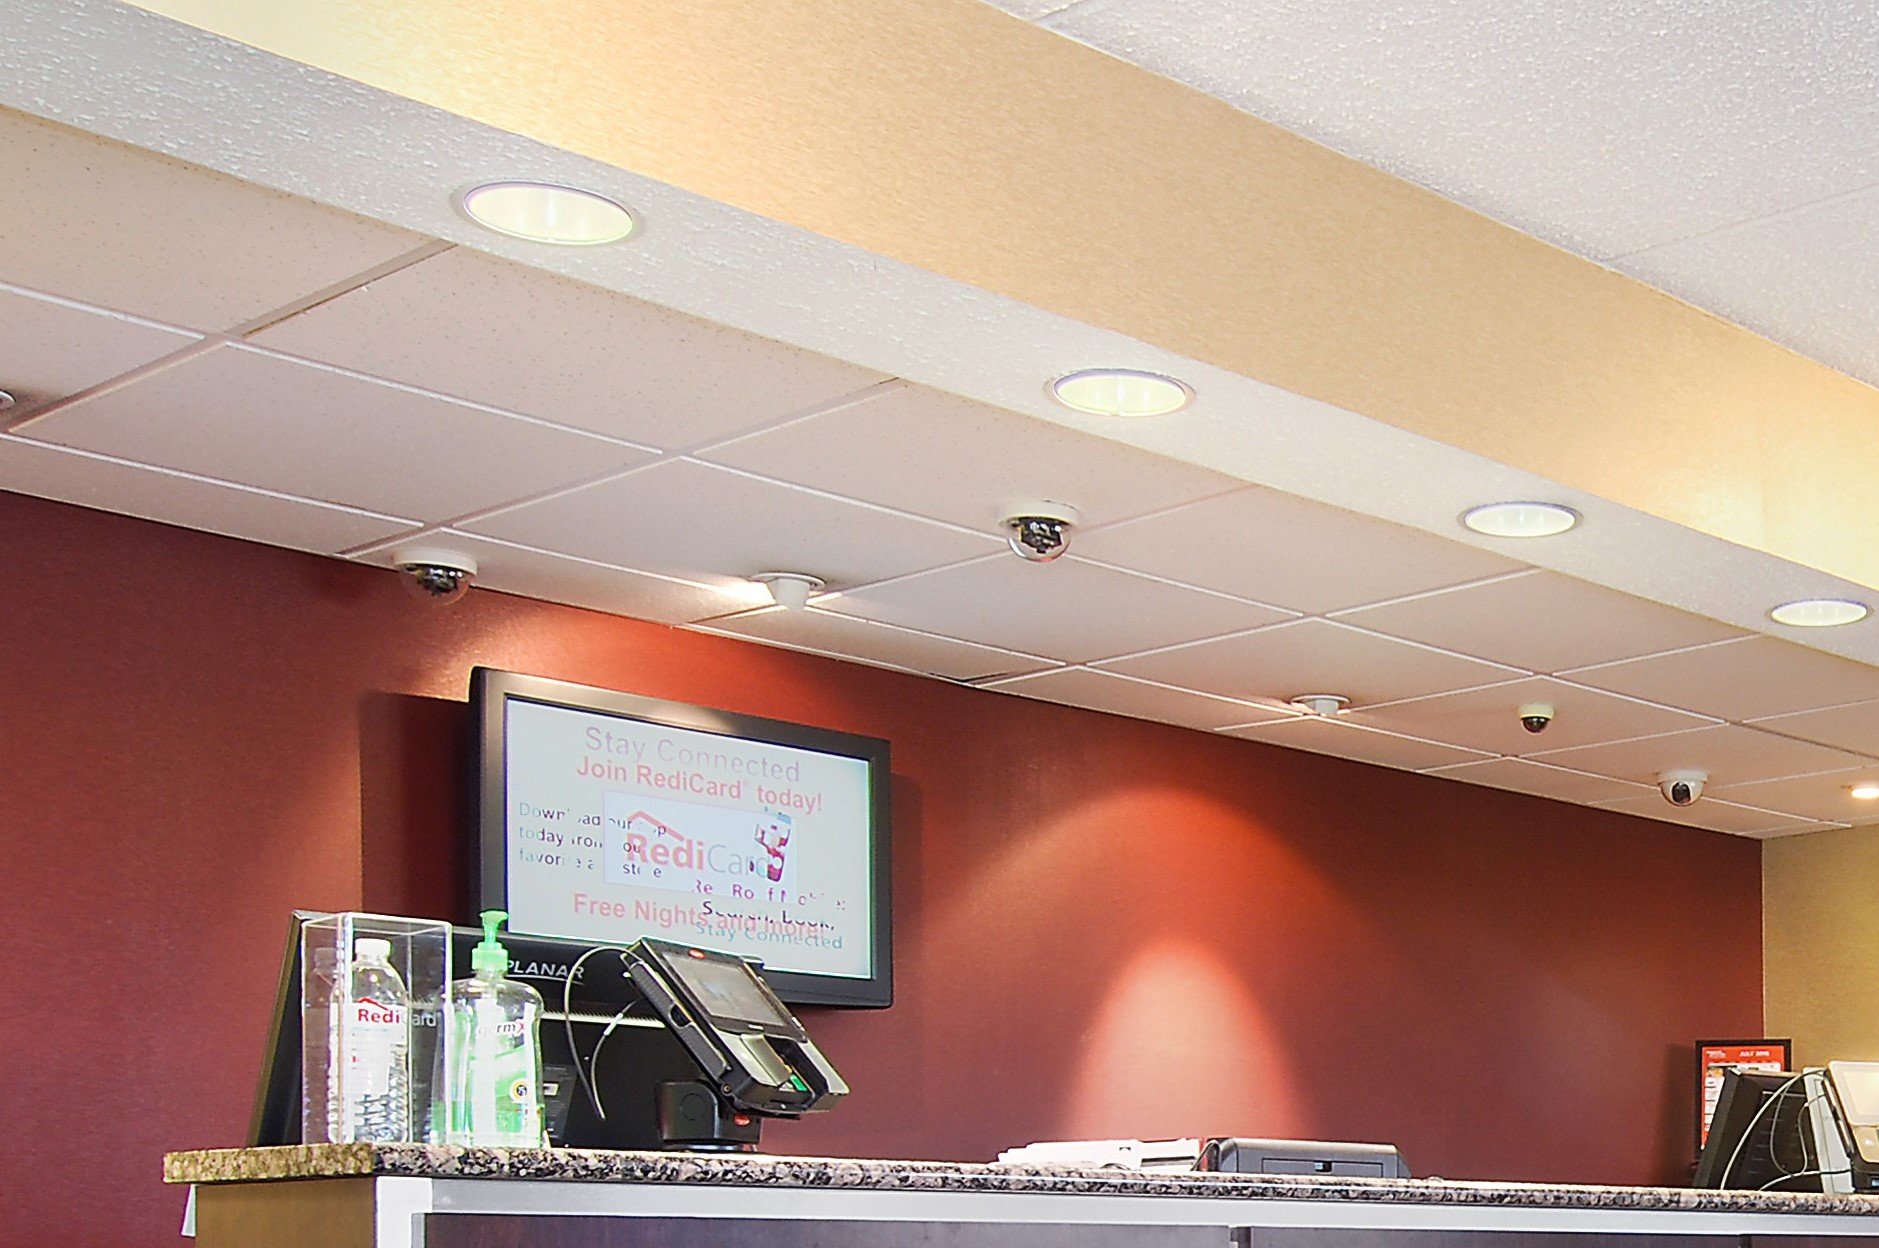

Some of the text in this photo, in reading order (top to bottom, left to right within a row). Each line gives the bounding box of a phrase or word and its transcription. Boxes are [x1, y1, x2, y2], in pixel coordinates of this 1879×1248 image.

[585, 727, 800, 783] Stay Connected
[577, 756, 822, 815] Join RediCard today!
[518, 827, 564, 847] today
[572, 892, 627, 921] Free
[635, 900, 708, 930] Nights
[744, 925, 843, 950] Connected
